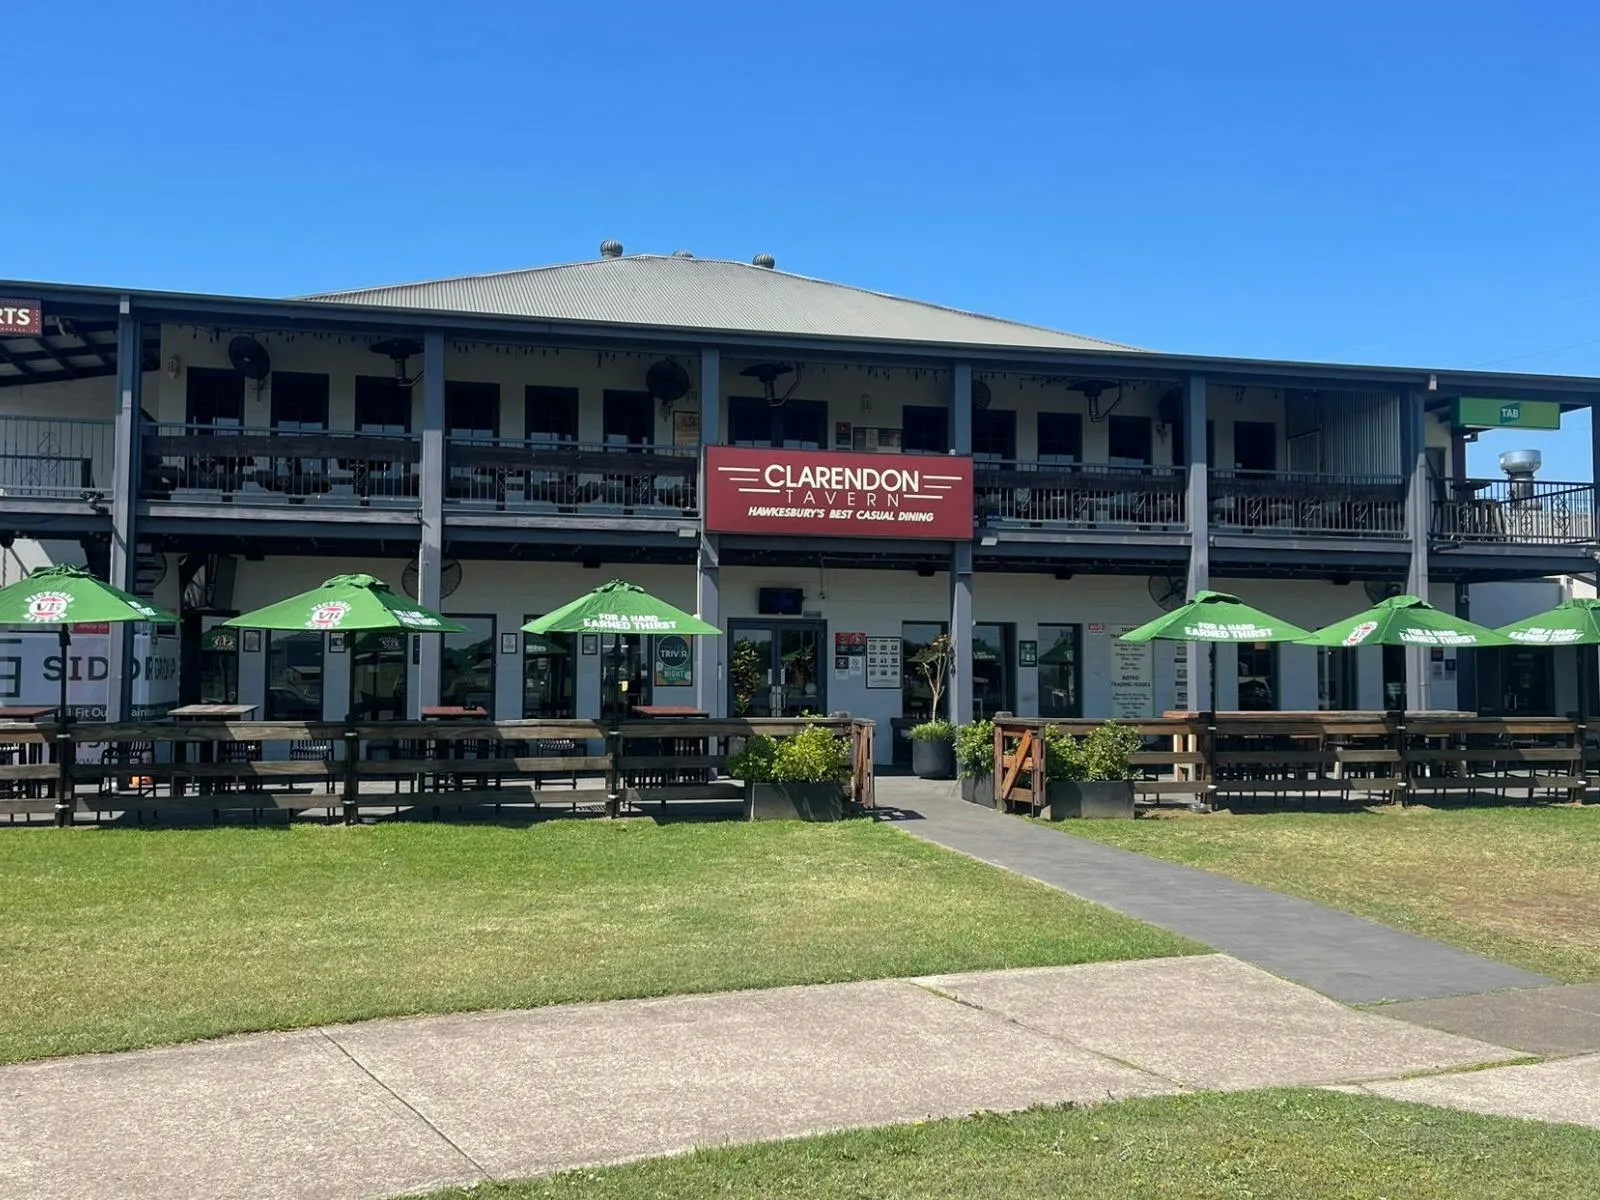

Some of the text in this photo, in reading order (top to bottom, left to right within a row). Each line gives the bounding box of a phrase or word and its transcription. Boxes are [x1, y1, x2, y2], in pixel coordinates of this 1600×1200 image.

[1501, 408, 1519, 418] TAB
[764, 464, 919, 493] CLARENDON
[786, 489, 899, 507] TAVERN
[748, 506, 934, 522] HAWKESBURY'S BEST CASUAL DINING
[598, 613, 619, 621] FOR
[583, 618, 678, 630] EARNED THIRST
[1197, 622, 1218, 630] FOR
[1183, 626, 1274, 638] EARNED THIRST
[75, 707, 90, 718] Fit
[91, 707, 108, 718] Ou
